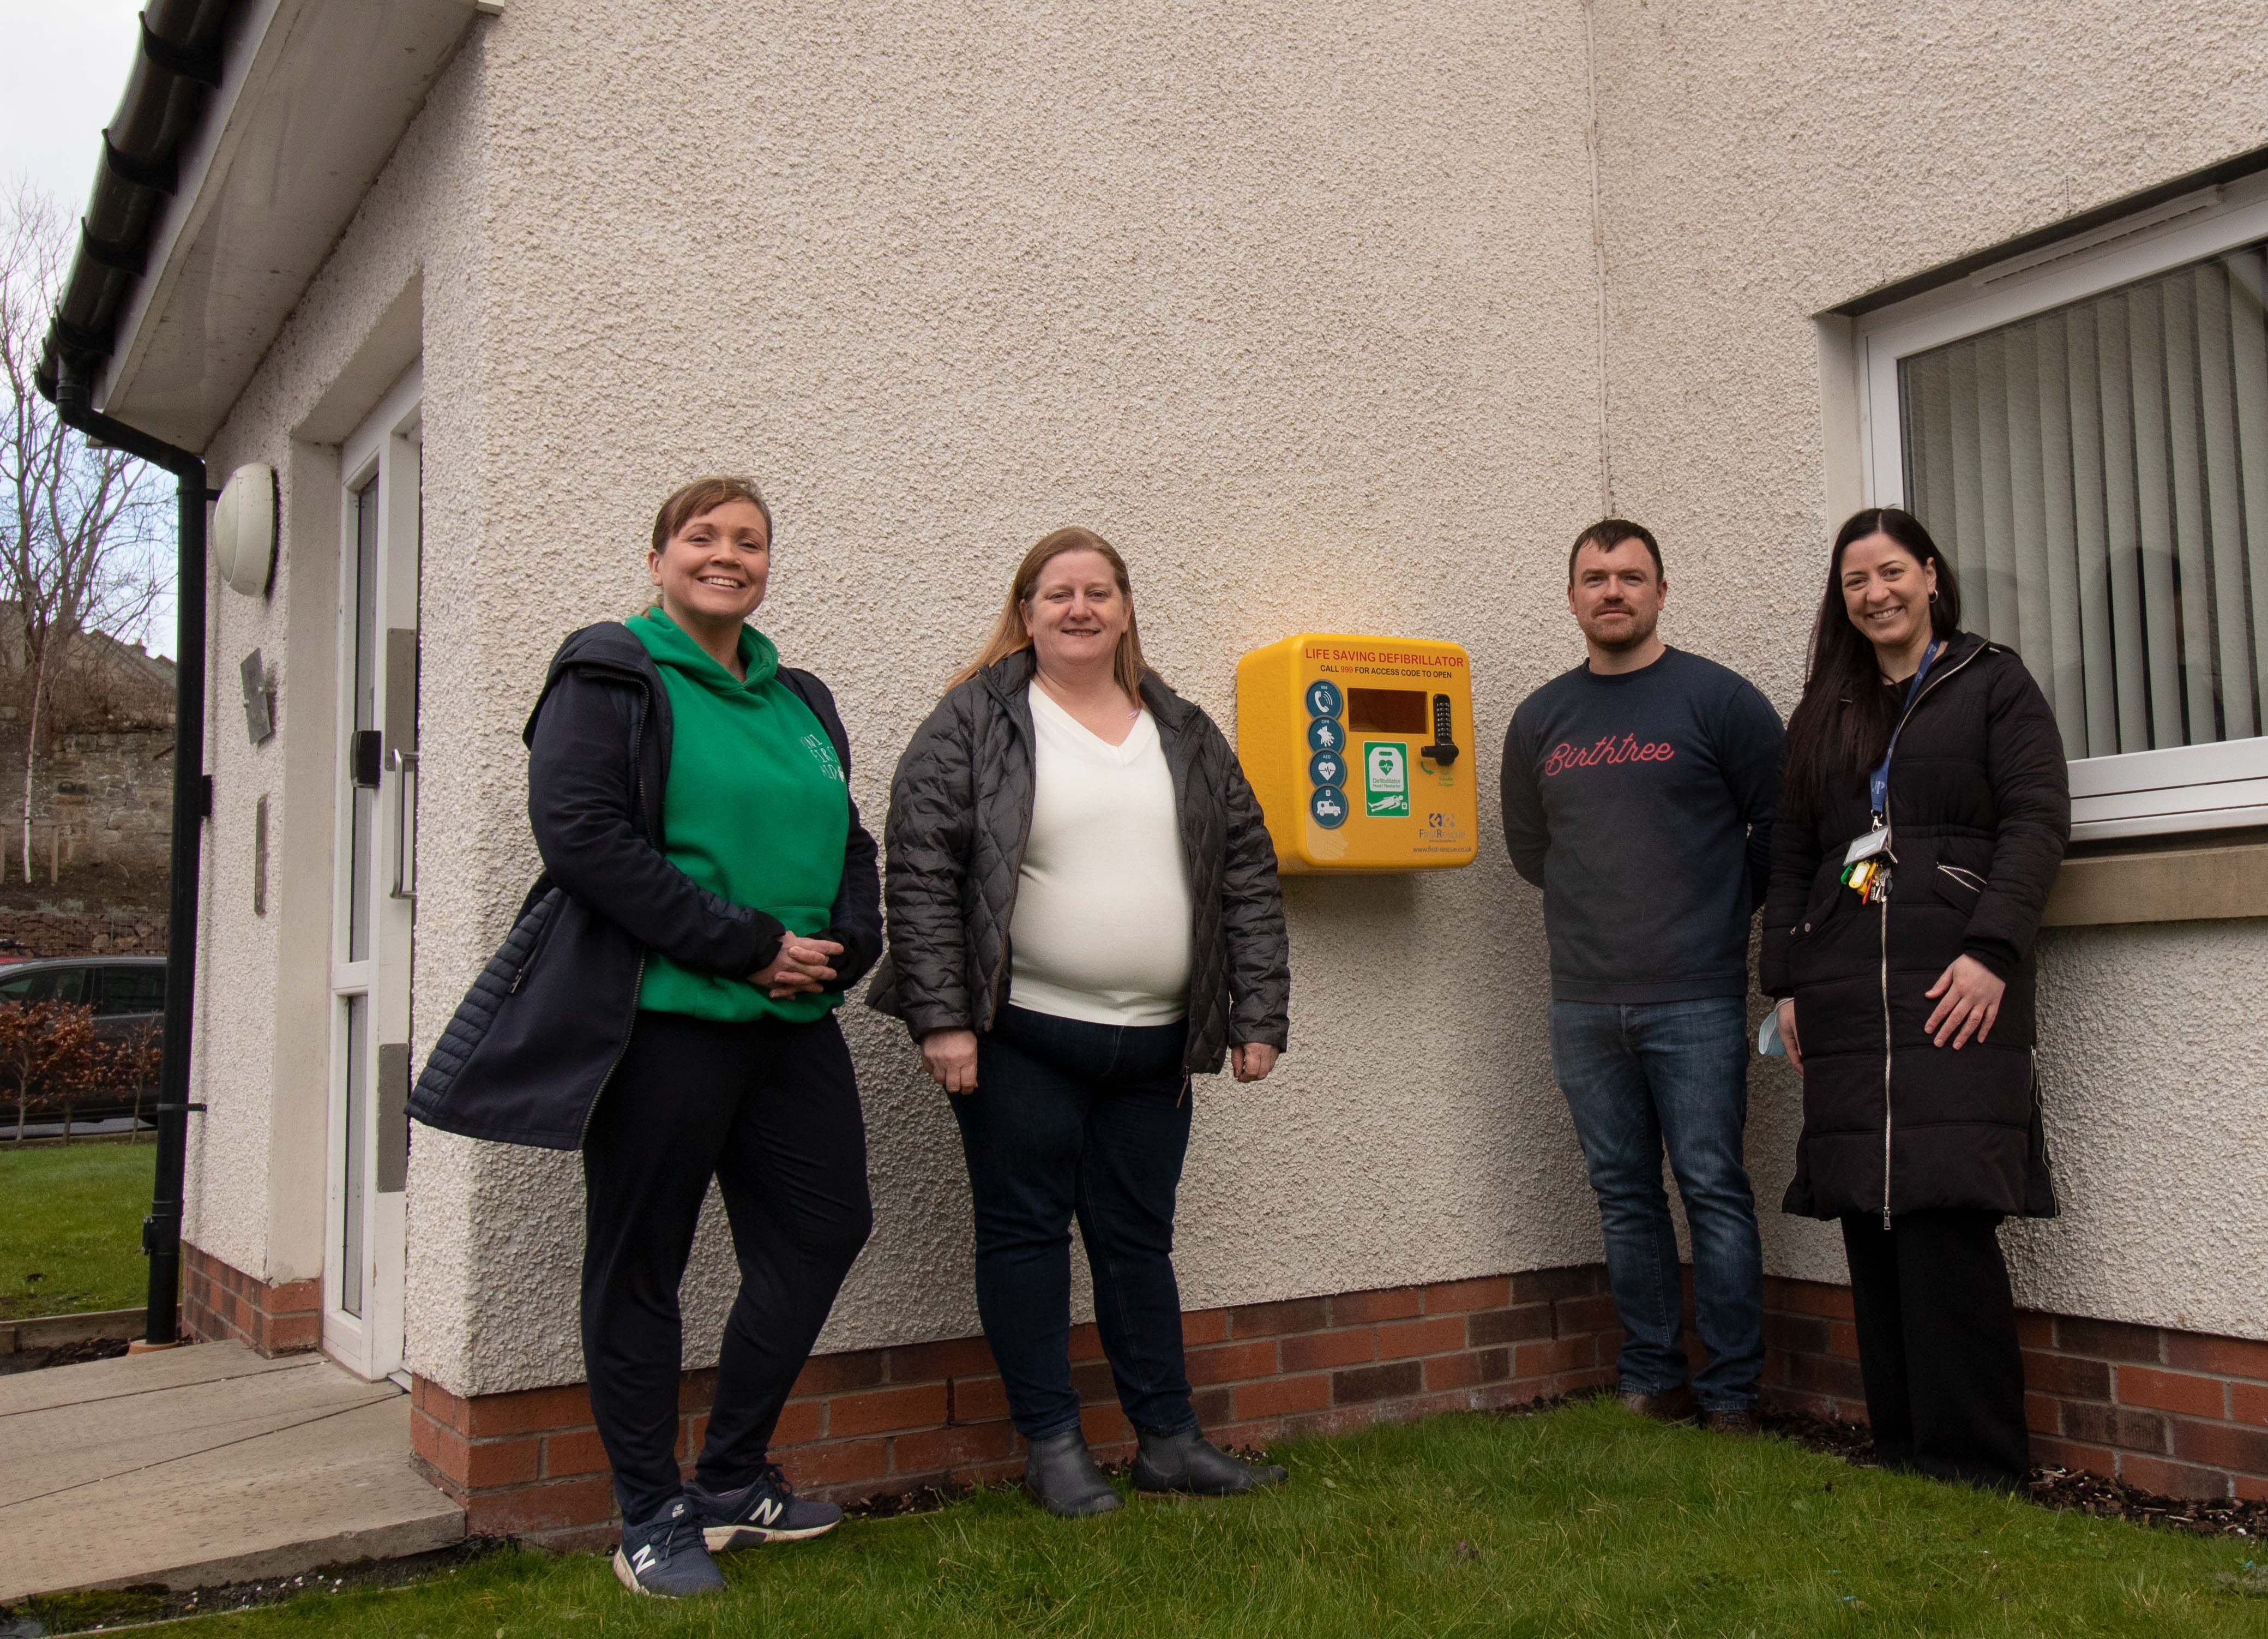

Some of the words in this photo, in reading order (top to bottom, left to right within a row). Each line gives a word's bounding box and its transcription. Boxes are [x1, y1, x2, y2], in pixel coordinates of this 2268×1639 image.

[1306, 649, 1329, 659] LIFE
[1333, 650, 1376, 662] SAVING
[1379, 653, 1464, 667] DEFIBRILLATOR
[1371, 668, 1399, 676] ACCESS
[1544, 733, 1675, 777] Birthtree
[749, 1498, 783, 1526] N
[632, 1544, 656, 1575] N
